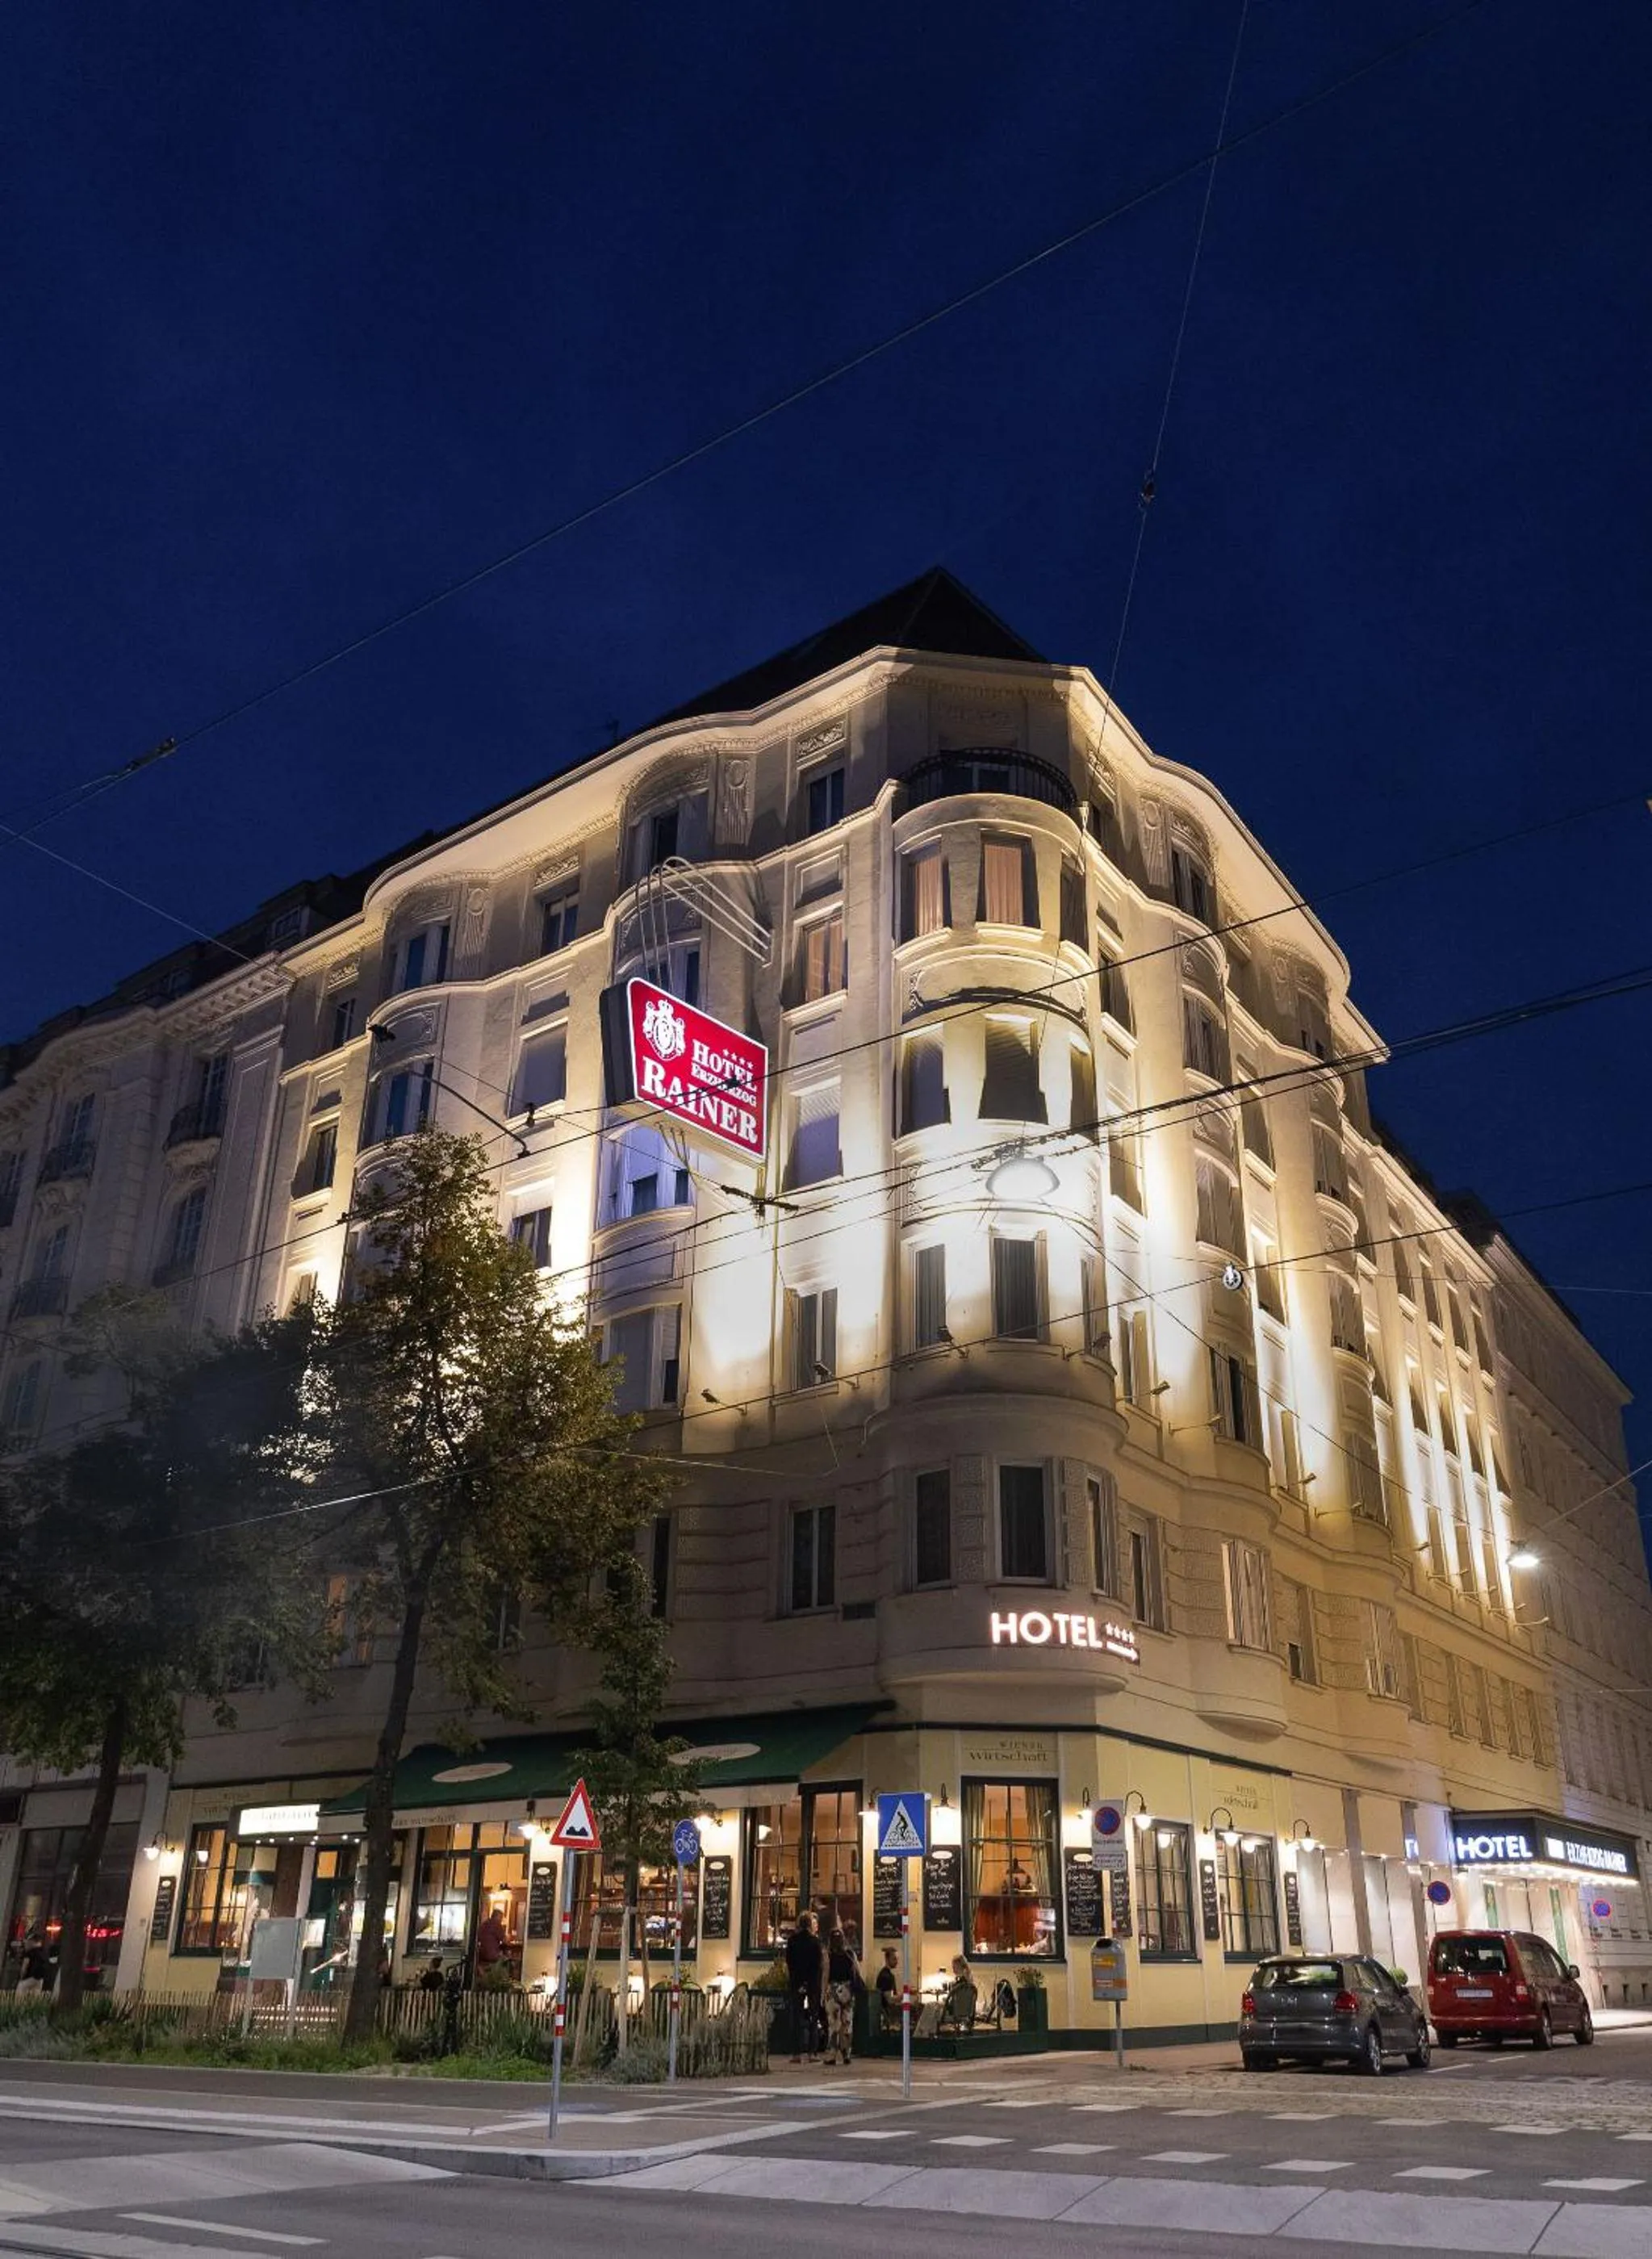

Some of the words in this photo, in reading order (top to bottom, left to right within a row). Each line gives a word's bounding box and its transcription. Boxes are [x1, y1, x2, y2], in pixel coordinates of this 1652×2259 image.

[692, 1040, 757, 1091] HOTEL
[642, 1056, 758, 1144] RAINER
[991, 1612, 1102, 1648] HOTEL
[1456, 1834, 1533, 1859] HOTEL
